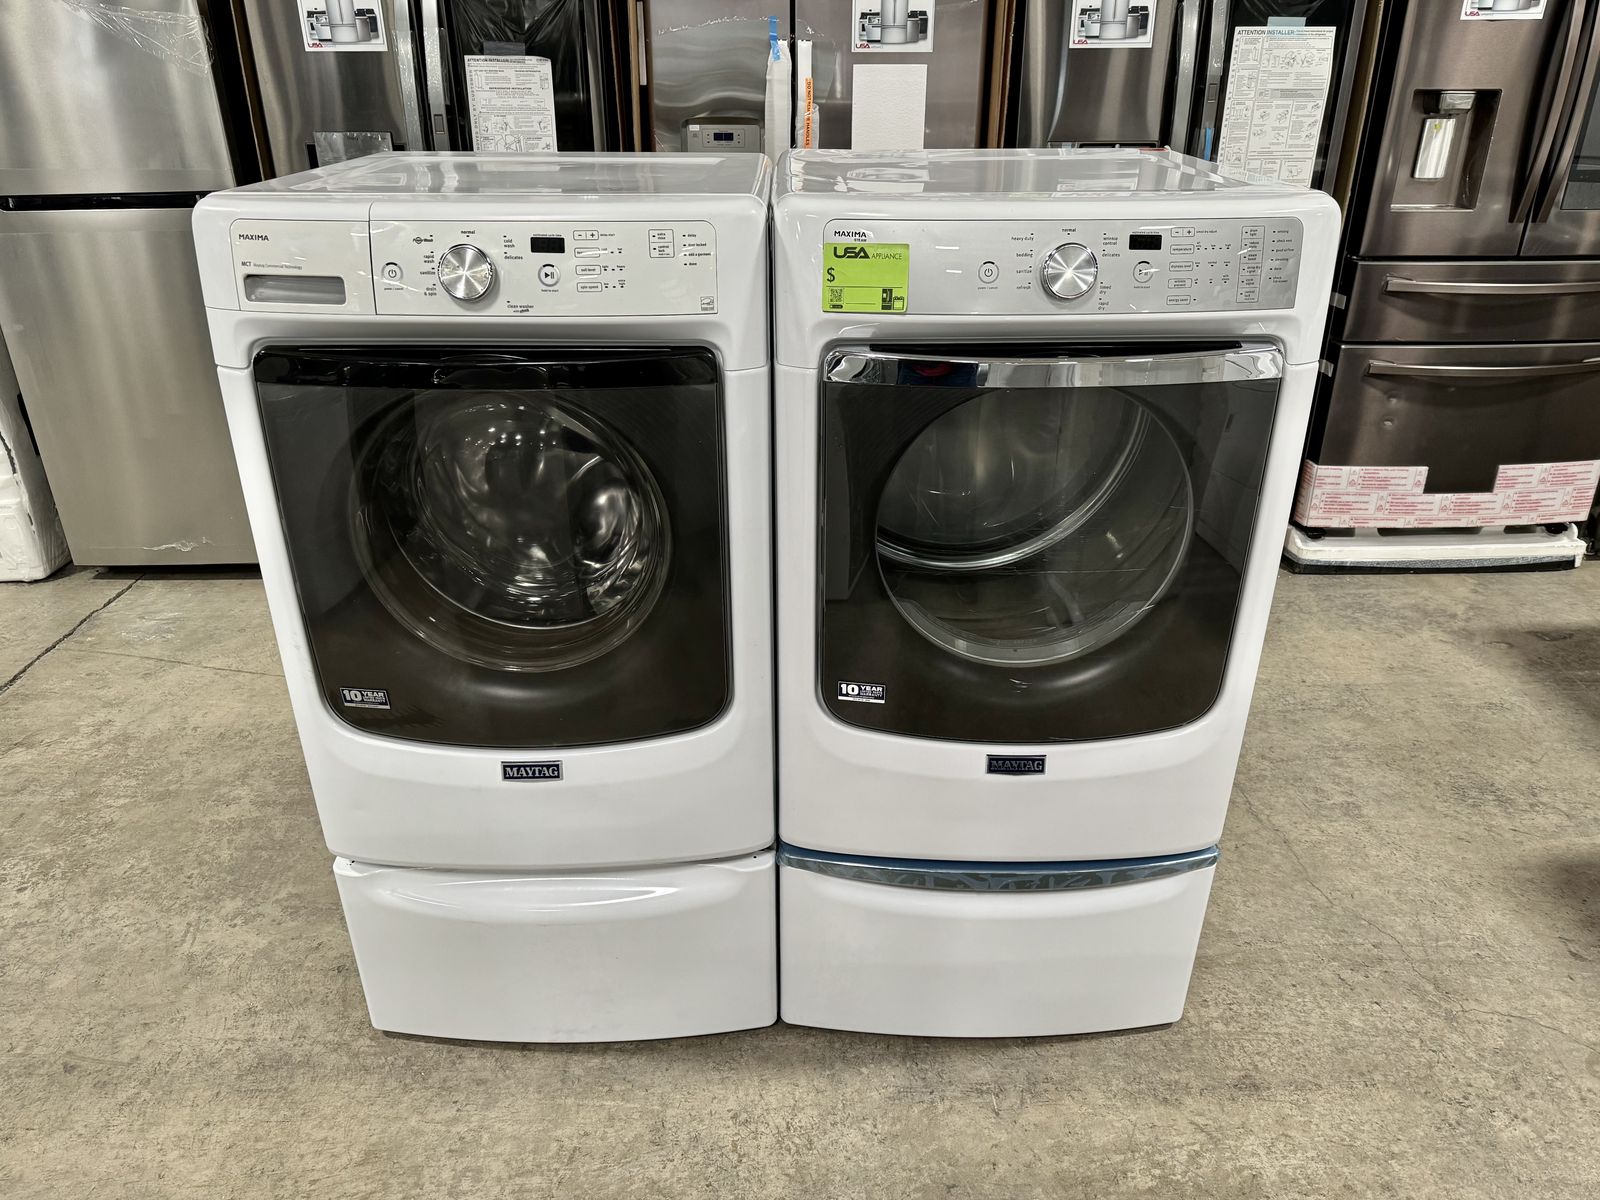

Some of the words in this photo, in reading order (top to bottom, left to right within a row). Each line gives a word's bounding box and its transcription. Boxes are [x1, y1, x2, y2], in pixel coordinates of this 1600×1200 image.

[833, 247, 870, 259] USA
[827, 267, 835, 283] $
[841, 684, 859, 694] 10
[343, 690, 362, 701] 10
[990, 761, 1042, 770] MAYTAG
[505, 767, 558, 777] MAYTAG
